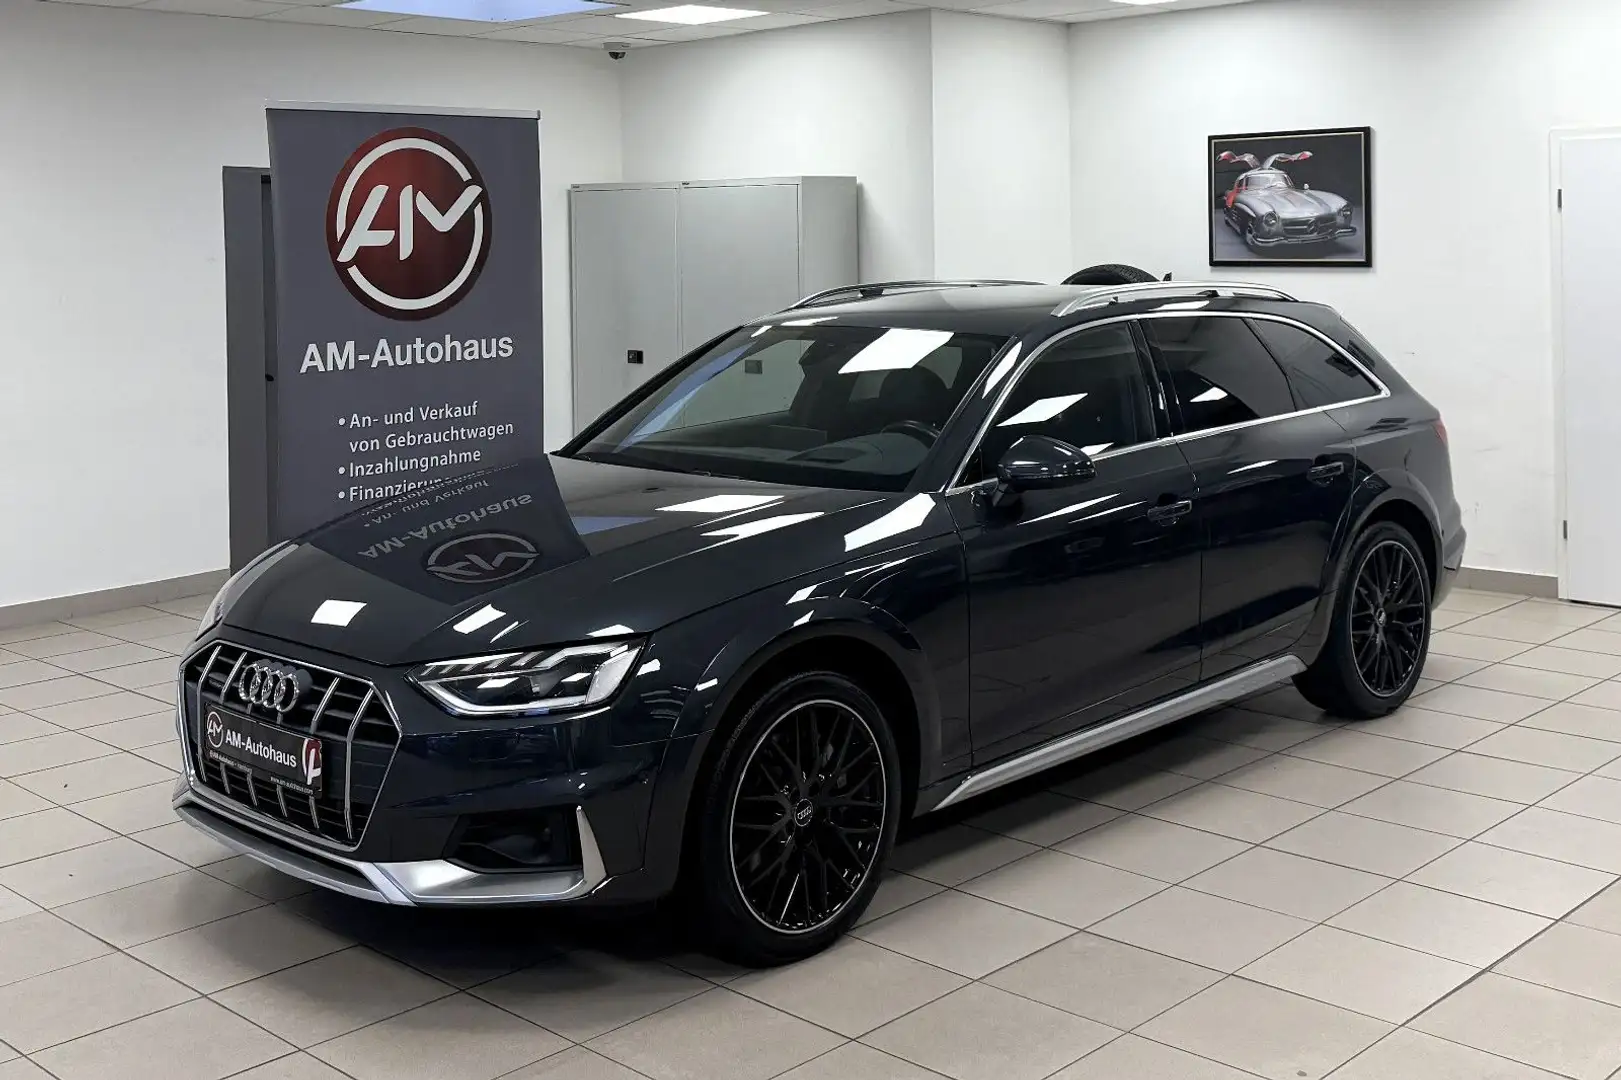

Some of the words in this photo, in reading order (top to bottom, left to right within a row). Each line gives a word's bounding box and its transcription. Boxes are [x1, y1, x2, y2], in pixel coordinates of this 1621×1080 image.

[299, 334, 514, 374] AM-Autohaus
[349, 413, 379, 429] An-
[384, 407, 414, 425] und
[419, 400, 479, 420] Verkauf
[349, 437, 380, 453] von
[385, 422, 514, 449] Gebrauchtwagen
[350, 448, 481, 478] Inzahlungnahme
[225, 728, 297, 768] AM-Autohaus
